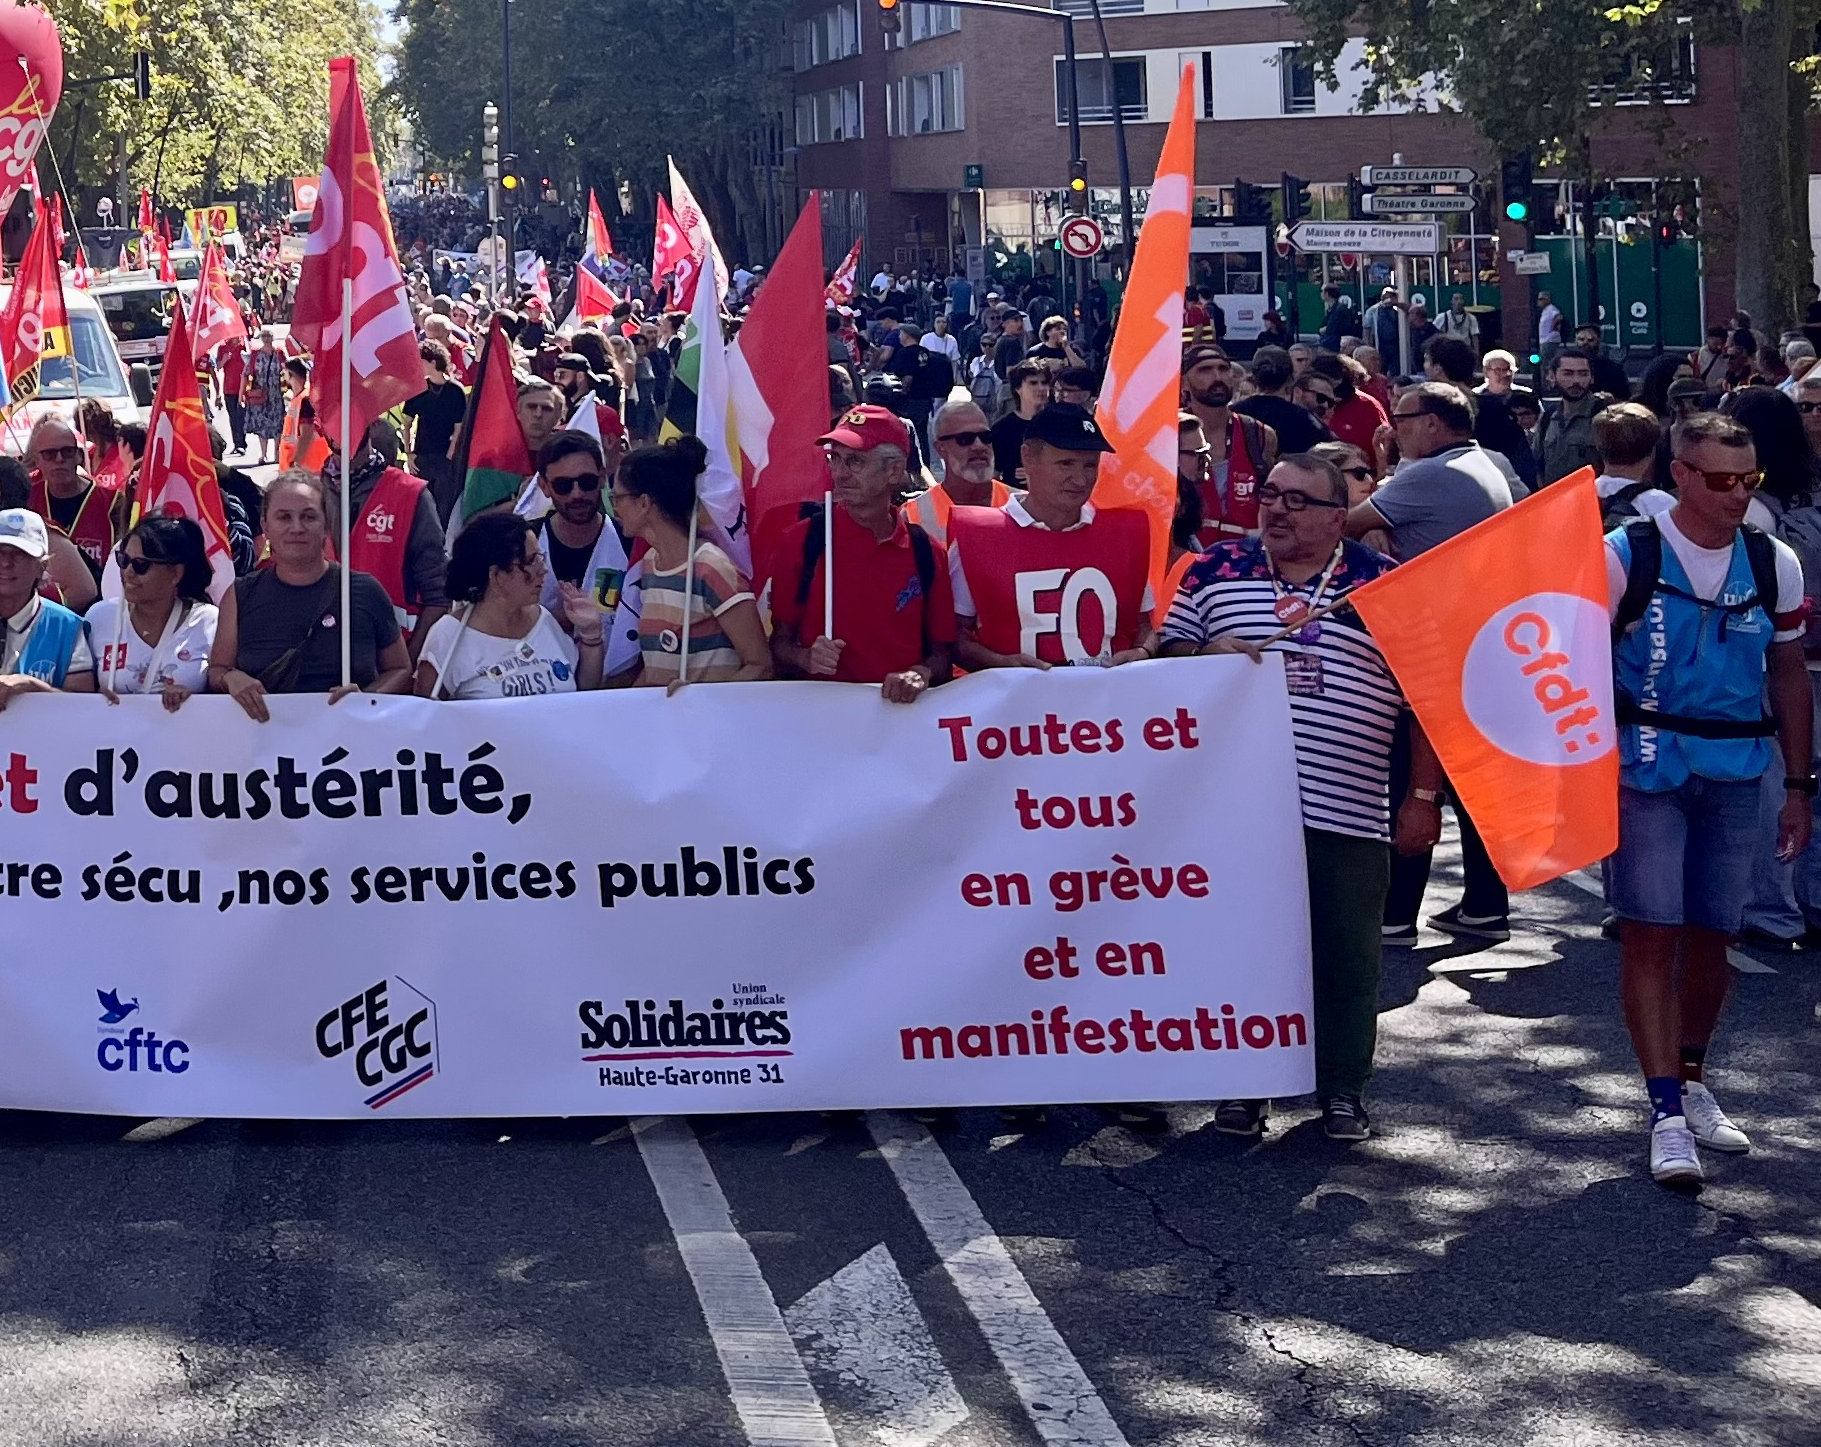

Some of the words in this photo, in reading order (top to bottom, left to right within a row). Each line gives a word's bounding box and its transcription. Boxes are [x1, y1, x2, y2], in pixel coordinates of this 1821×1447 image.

[1375, 170, 1460, 181] CASSELARDIT
[1420, 199, 1465, 209] Garonne
[1305, 228, 1340, 237] Maison
[1344, 228, 1355, 237] de
[1358, 228, 1367, 237] la
[1370, 228, 1433, 239] Citoyenneté
[96, 472, 117, 486] cgt
[366, 513, 395, 533] cgt
[1015, 566, 1117, 666] FO
[1503, 611, 1601, 753] Cfdt:
[938, 714, 1124, 762] Toutes
[1142, 707, 1200, 751] et
[1015, 789, 1138, 831] tous
[81, 850, 201, 904] sécu
[350, 852, 576, 902] services
[597, 845, 816, 908] publics
[961, 871, 1032, 907] en
[1049, 854, 1210, 912] grève
[1023, 936, 1079, 980] et
[1095, 940, 1166, 976] en
[732, 983, 767, 994] Union
[732, 994, 786, 1006] syndicale
[316, 979, 389, 1058] CFE
[579, 998, 791, 1049] Solidaires
[900, 1003, 1308, 1061] manifestation
[97, 1027, 190, 1074] cftc
[356, 1007, 431, 1087] CGC
[598, 1066, 752, 1087] Haute-Garonne
[756, 1063, 784, 1084] 31
